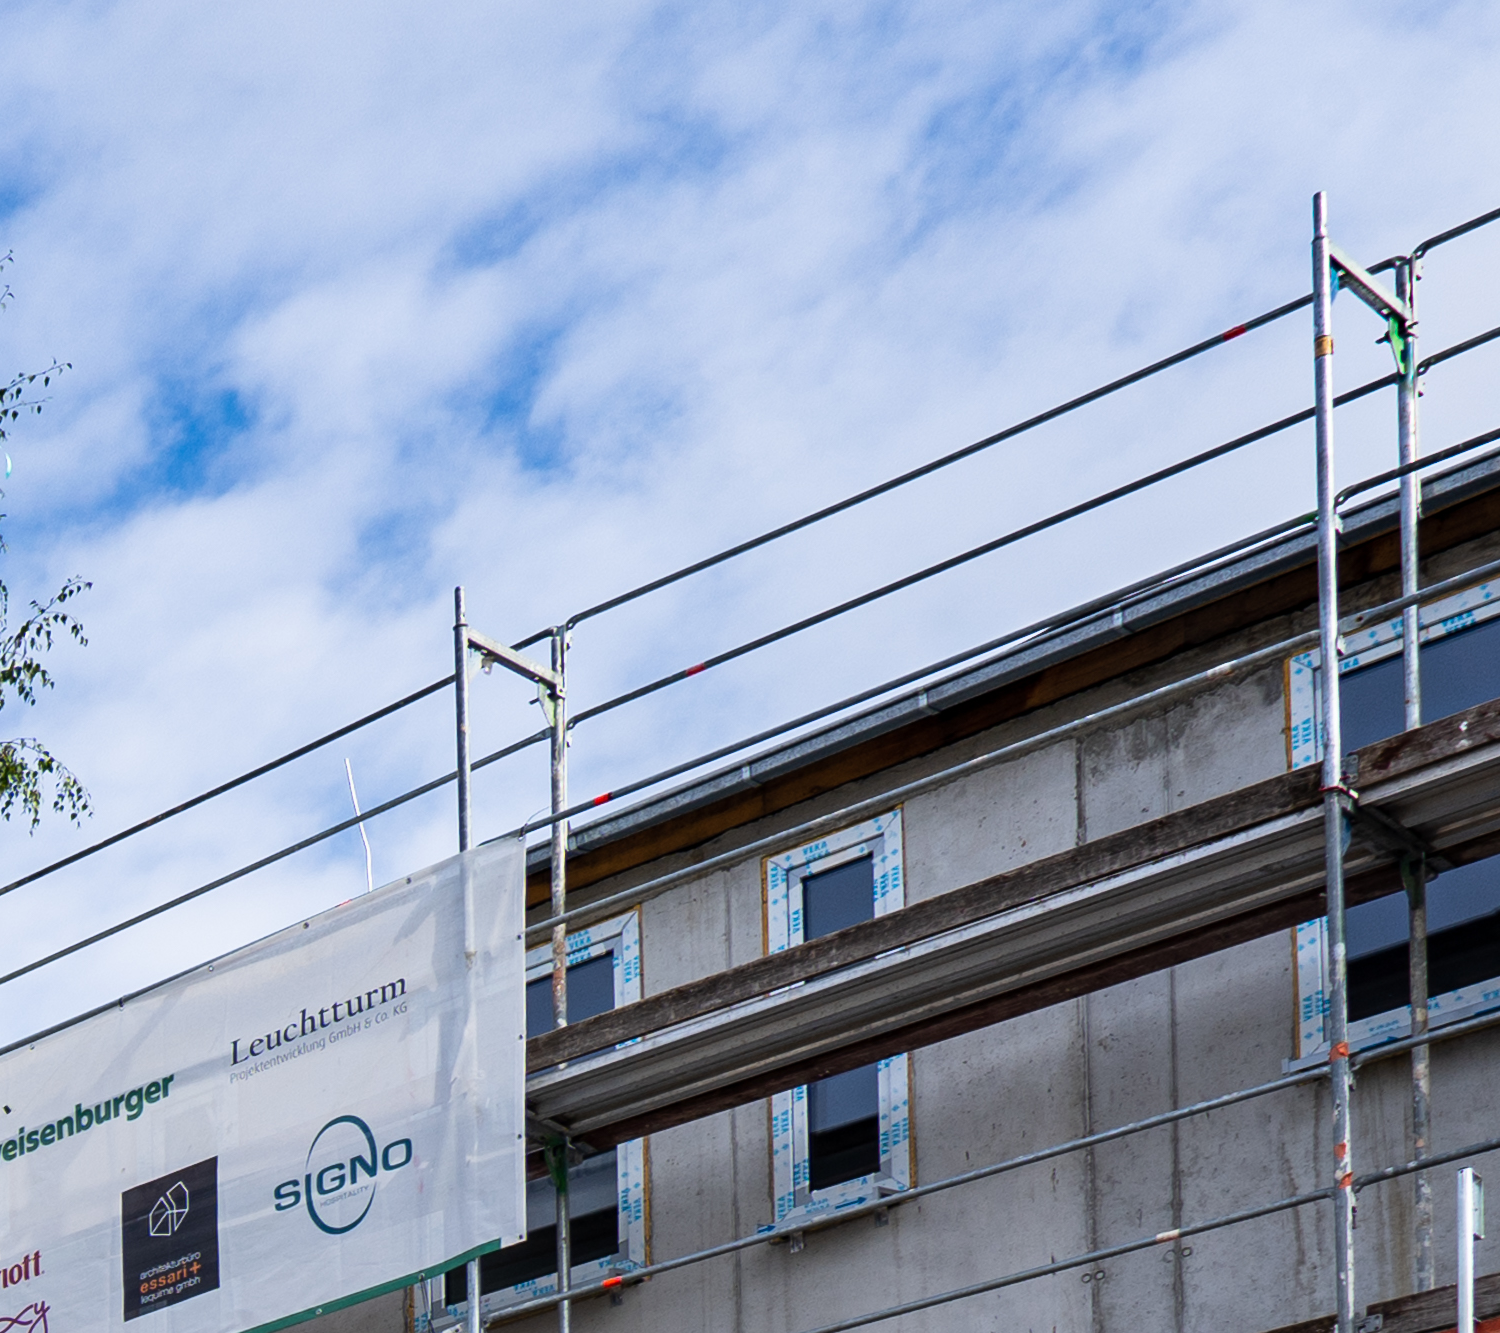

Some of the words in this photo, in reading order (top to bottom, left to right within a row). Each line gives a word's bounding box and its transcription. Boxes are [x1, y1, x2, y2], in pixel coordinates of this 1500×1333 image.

[1301, 717, 1312, 745] VEKA
[802, 841, 828, 856] VEKA
[770, 866, 779, 890] VEKA
[880, 871, 890, 899] VEKA
[890, 865, 900, 890] VEKA
[792, 908, 800, 935] VEKA
[569, 936, 591, 951] VEKA
[623, 961, 632, 983] VEKA
[1302, 994, 1313, 1022] VEKA
[230, 978, 407, 1066] Leuchtturm
[229, 1037, 326, 1084] Projektentwicklung
[329, 1021, 361, 1044] GmbH
[364, 1017, 371, 1029] &
[375, 1011, 389, 1024] Co.
[392, 1002, 408, 1017] KG
[780, 1109, 789, 1135] VEKA
[892, 1121, 901, 1146] VEKA
[881, 1130, 890, 1157] VEKA
[274, 1138, 413, 1212] SIGNO
[320, 1185, 369, 1208] HOSPITALITY
[621, 1187, 630, 1213] VEKA
[633, 1198, 642, 1221] VEKA
[777, 1194, 786, 1220] VEKA
[139, 1251, 201, 1280] architekturbüro
[140, 1284, 174, 1305] lequime
[175, 1275, 201, 1294] gmbh
